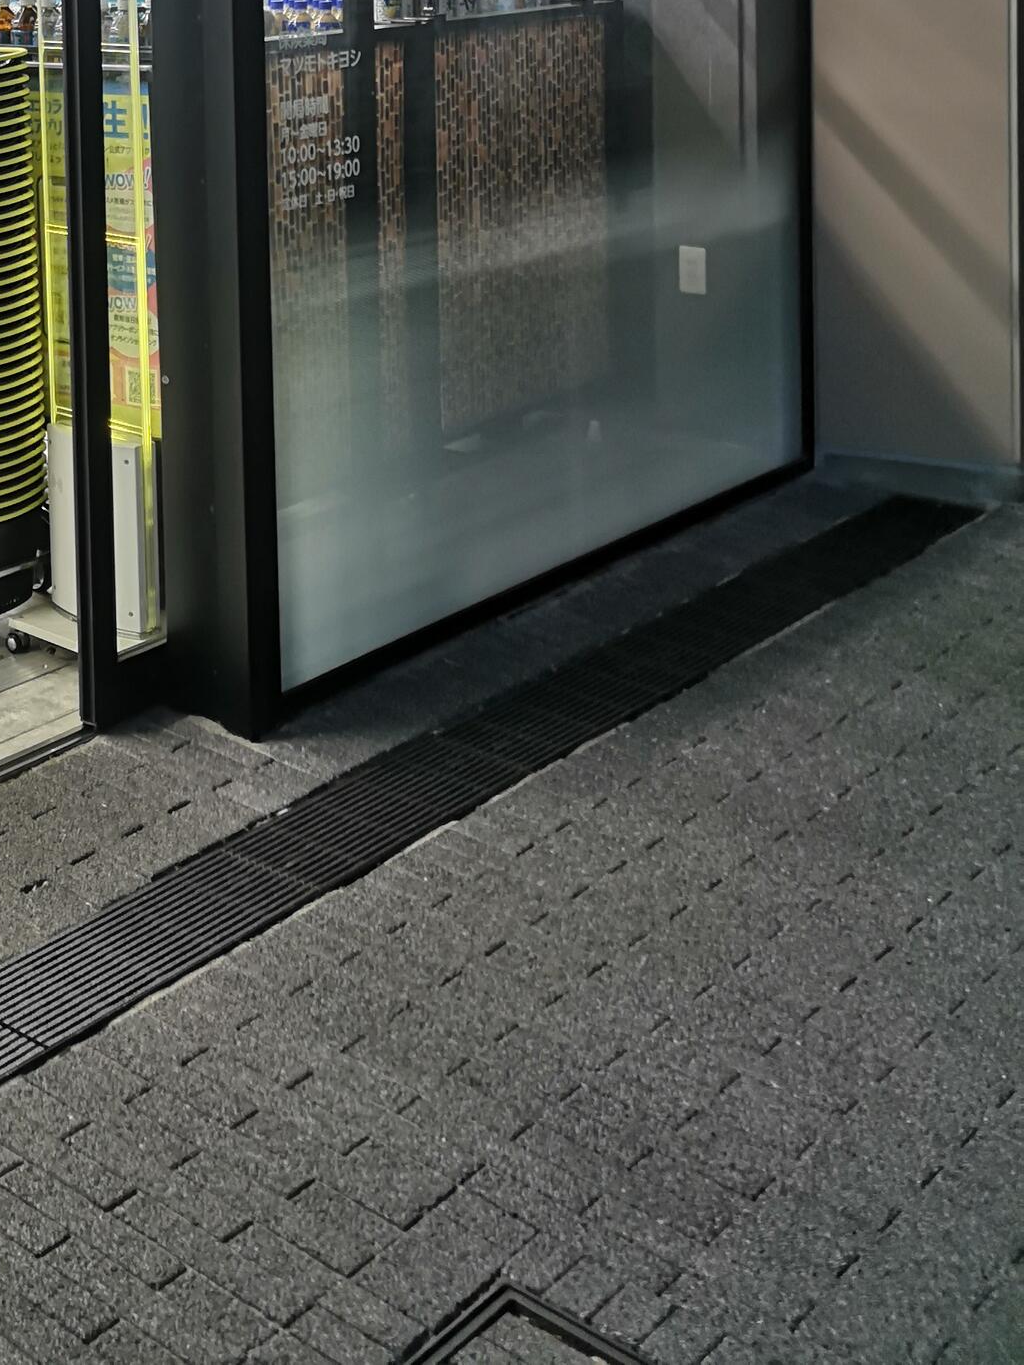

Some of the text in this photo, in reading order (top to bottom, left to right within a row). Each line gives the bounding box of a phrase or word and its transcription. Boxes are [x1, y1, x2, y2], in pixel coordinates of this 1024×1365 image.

[280, 49, 362, 76] マツモトキヨシ
[280, 135, 361, 165] 10:00~13:30
[280, 158, 361, 189] 15:00~19:00
